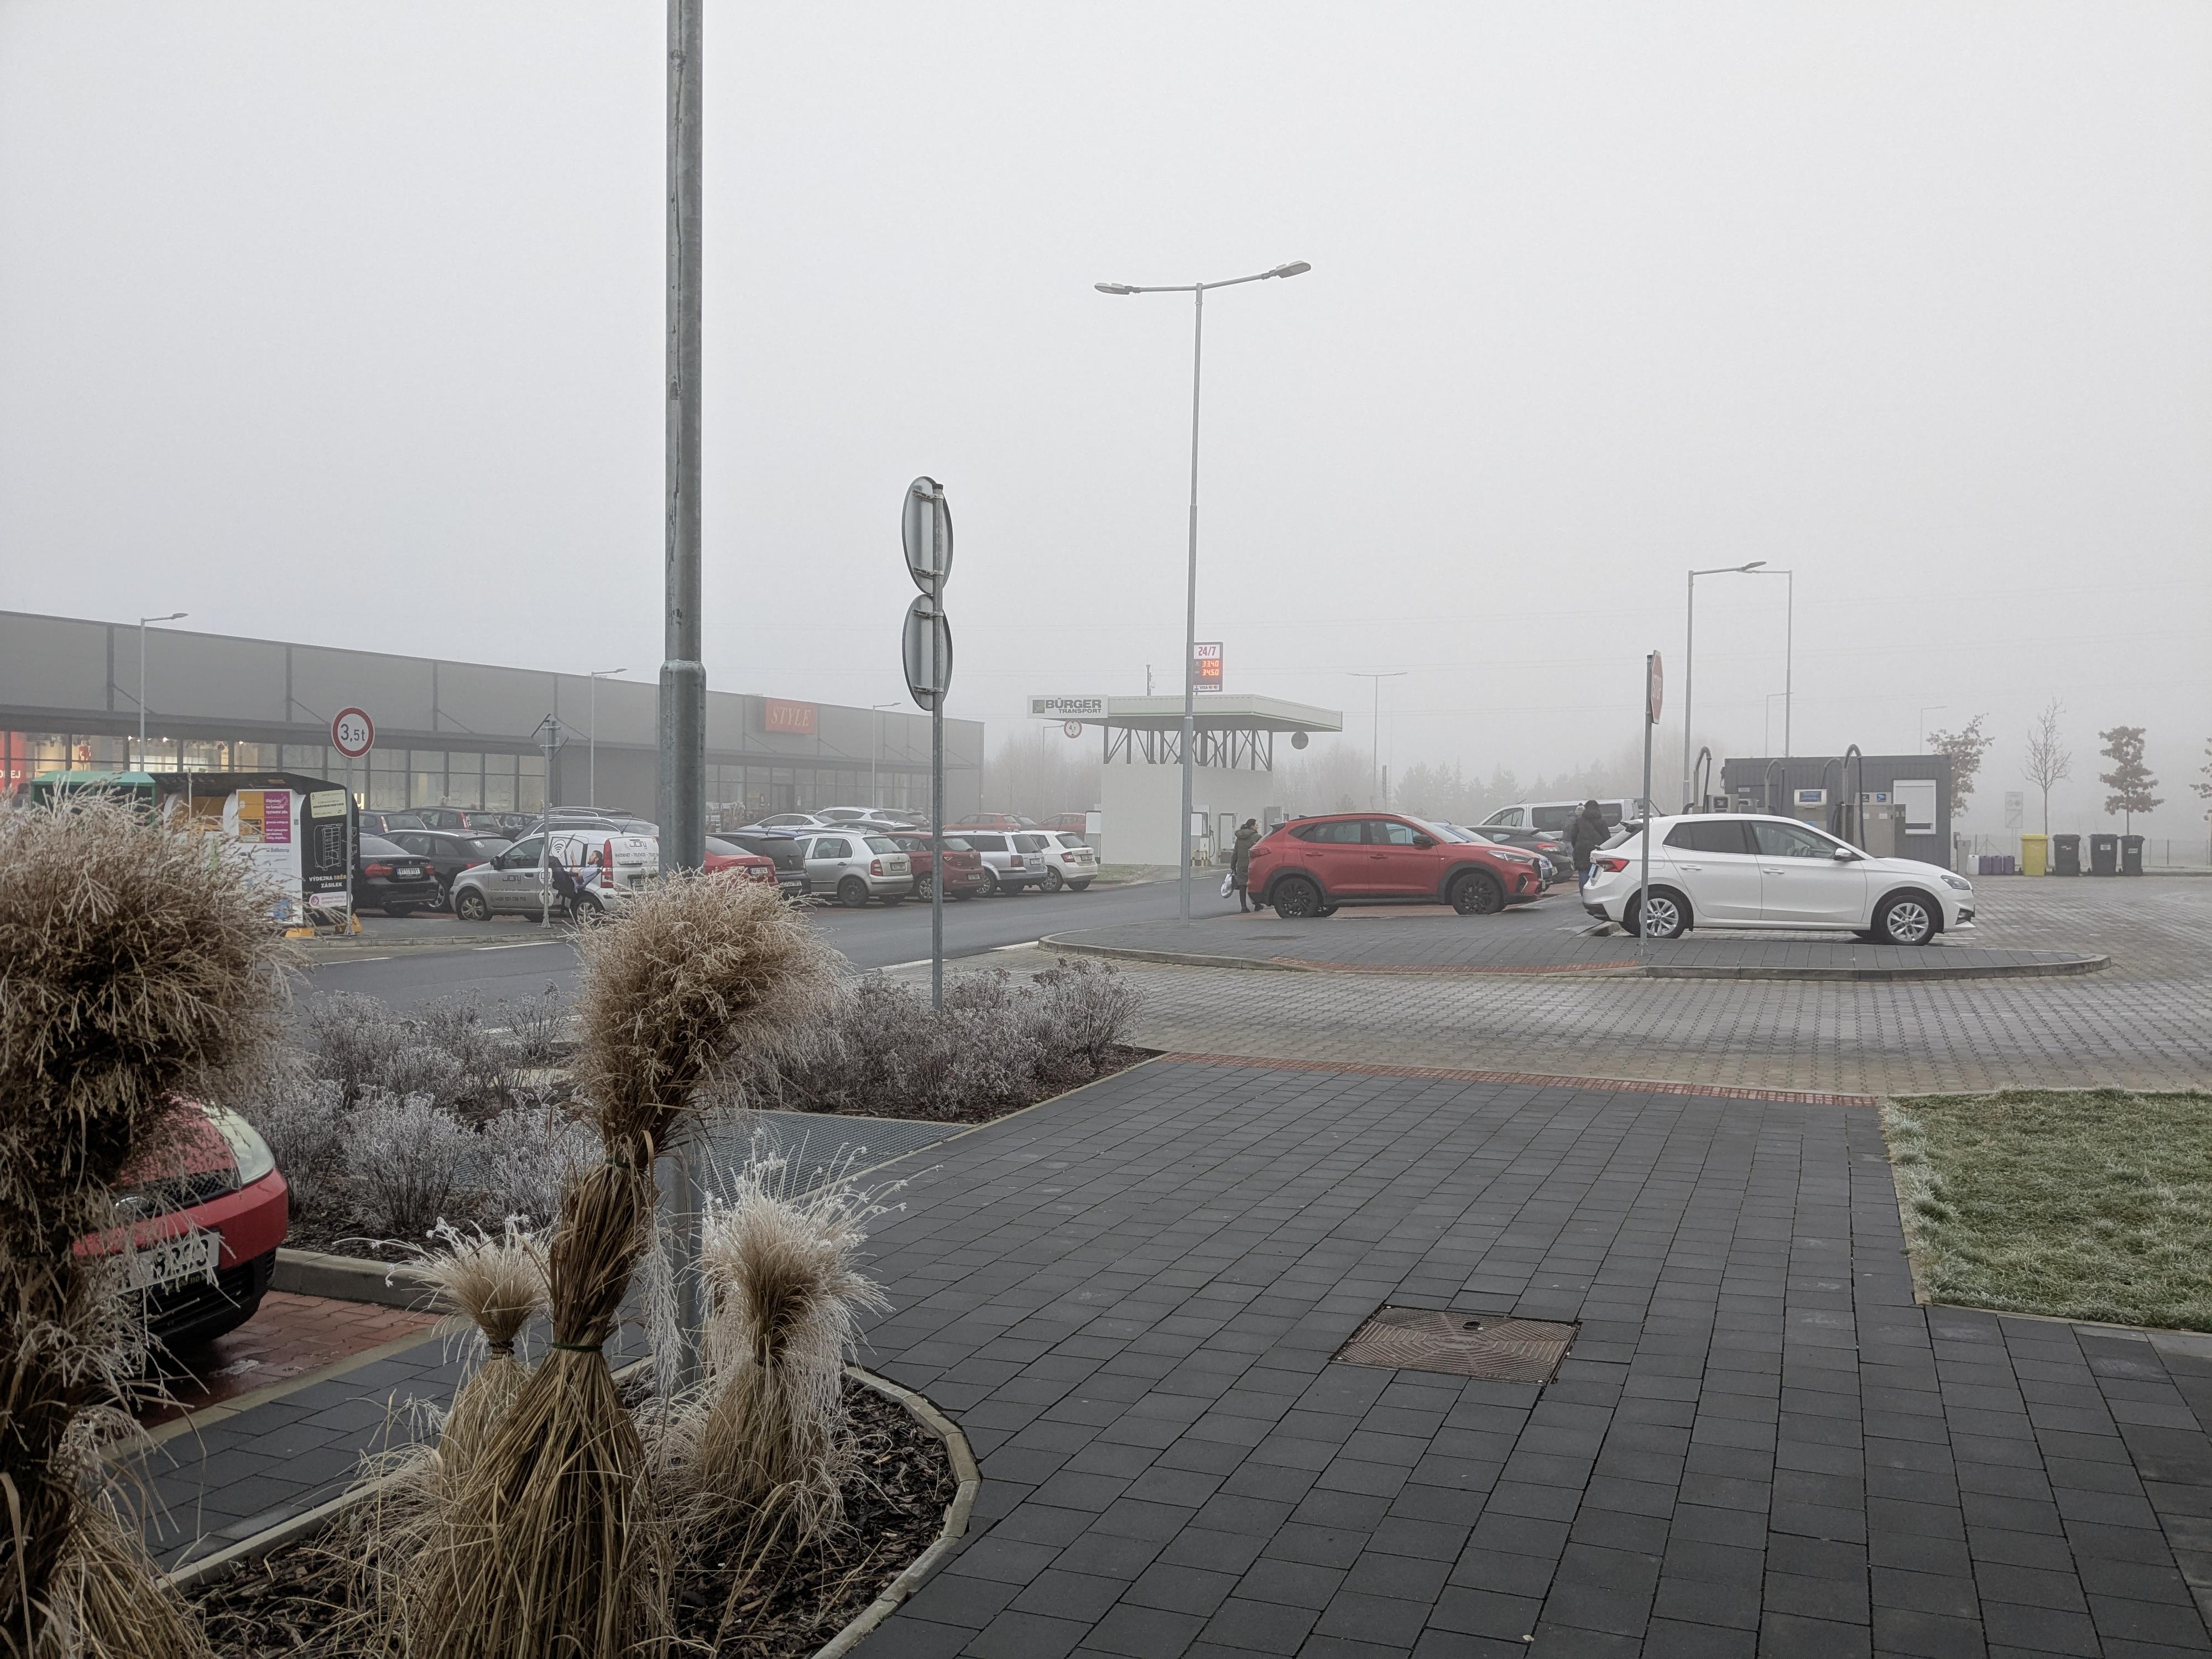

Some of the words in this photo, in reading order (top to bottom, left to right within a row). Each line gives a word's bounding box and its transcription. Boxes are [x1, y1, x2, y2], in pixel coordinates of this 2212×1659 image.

[1198, 646, 1217, 656] 24/7
[1046, 697, 1102, 708] BÜRGER
[771, 707, 811, 726] STYLE
